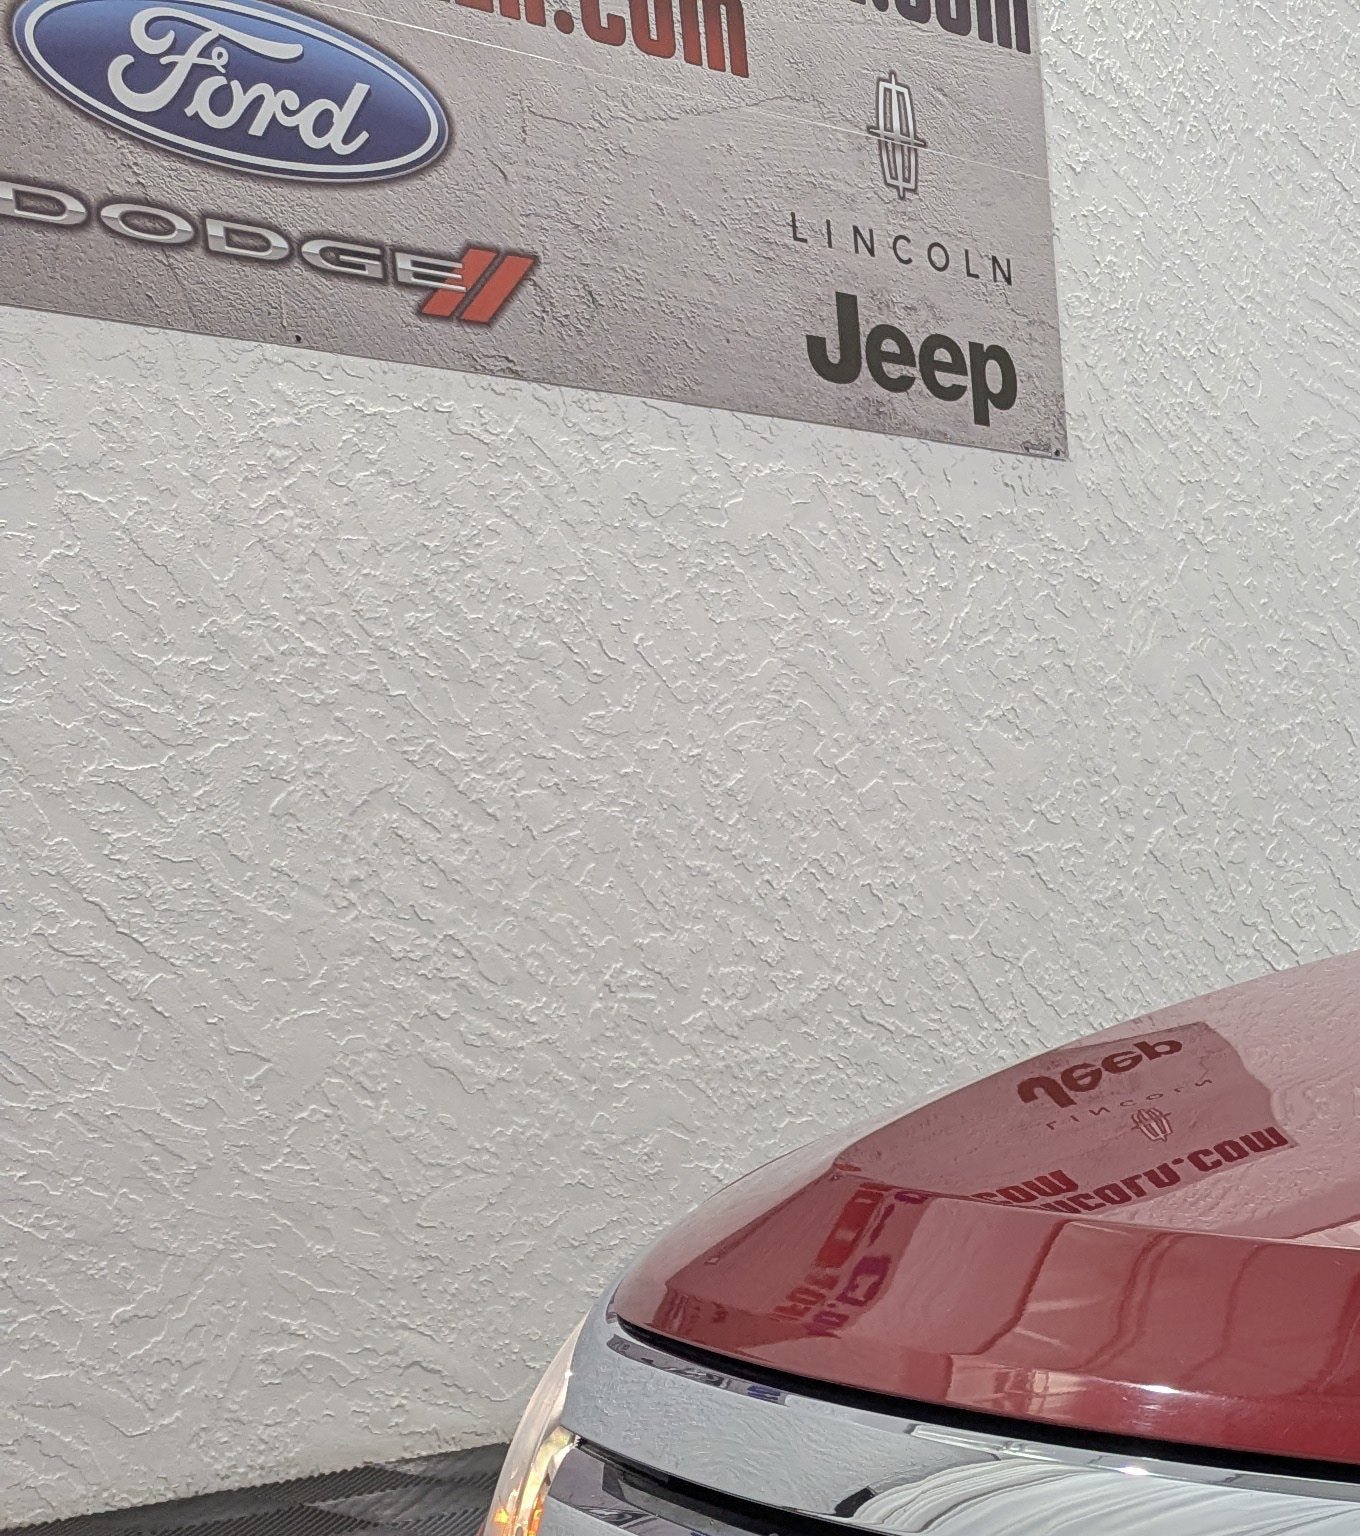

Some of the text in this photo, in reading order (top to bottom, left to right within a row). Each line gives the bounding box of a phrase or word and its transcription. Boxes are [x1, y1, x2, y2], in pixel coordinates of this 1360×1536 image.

[107, 6, 370, 155] Ford
[0, 181, 467, 292] DODGE
[790, 212, 1013, 286] LINCOLN
[806, 291, 1018, 426] Jeep
